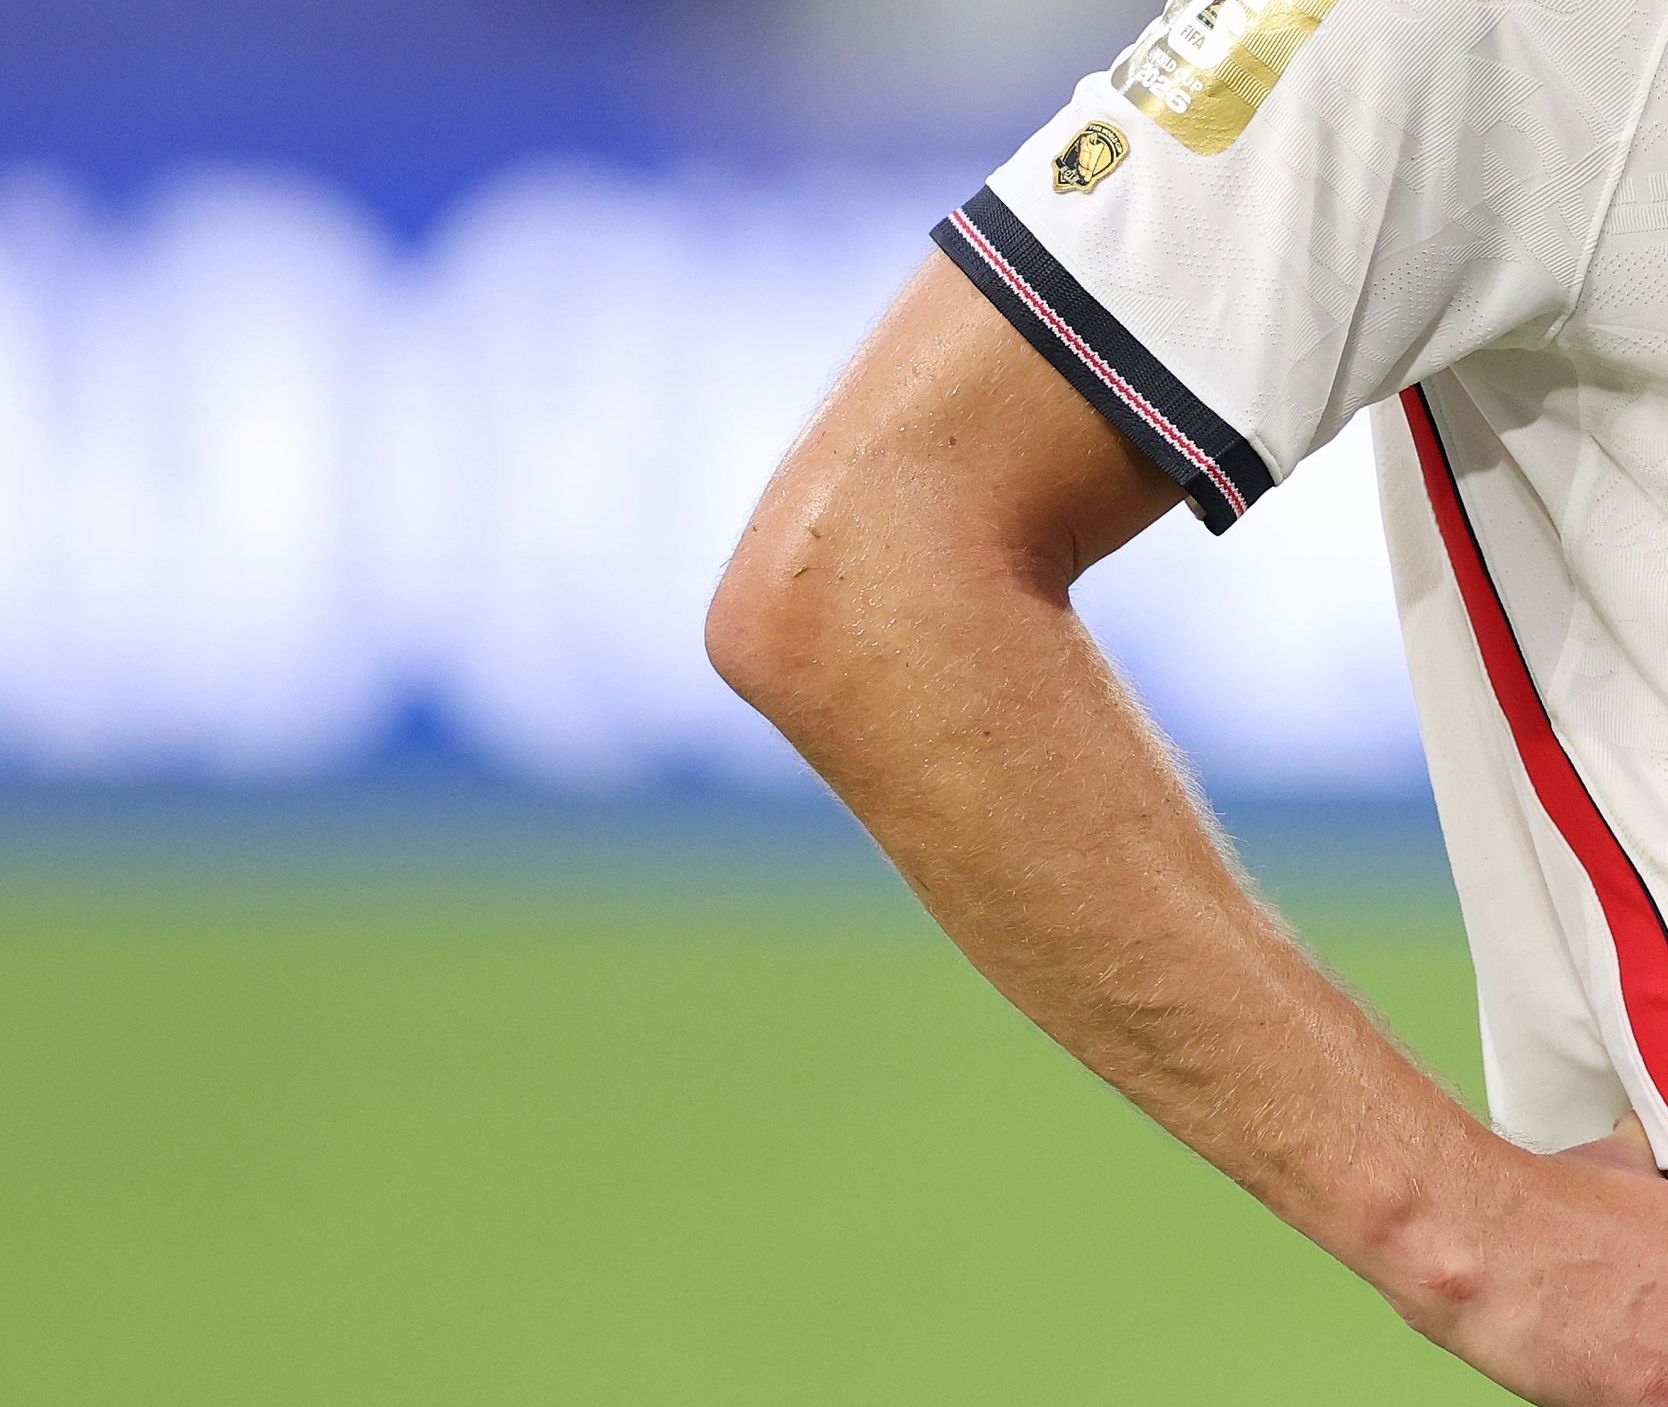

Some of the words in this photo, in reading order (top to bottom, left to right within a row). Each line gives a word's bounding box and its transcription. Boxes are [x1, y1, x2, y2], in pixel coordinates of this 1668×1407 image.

[1180, 24, 1206, 50] FIFA
[1136, 63, 1192, 114] 2026
[1174, 67, 1204, 91] CUP
